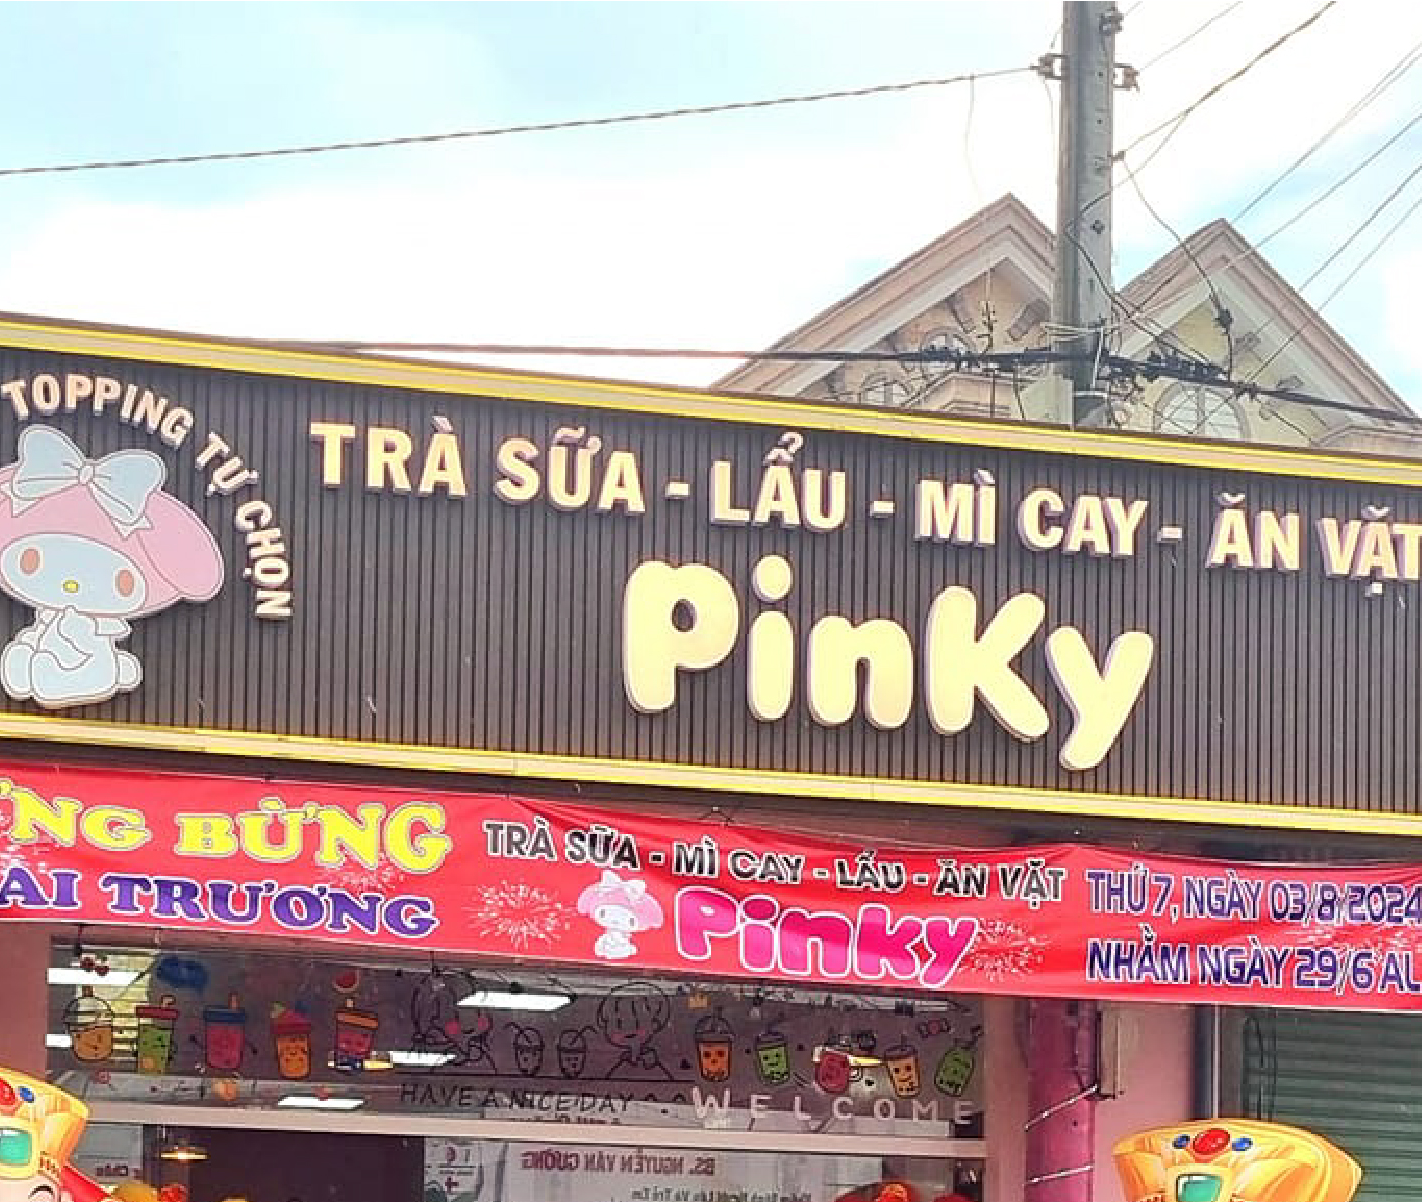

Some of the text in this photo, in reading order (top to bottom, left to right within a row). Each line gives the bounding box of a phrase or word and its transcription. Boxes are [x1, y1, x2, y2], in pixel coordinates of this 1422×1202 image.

[1, 372, 194, 448] TOPPING
[195, 431, 258, 499] TỰ
[233, 498, 293, 621] CHỌN
[309, 416, 467, 498] TRÀ
[493, 427, 646, 513] SỮA
[709, 431, 847, 532] LẨU
[913, 469, 996, 547] MÌ
[1017, 487, 1149, 557] CAY
[1205, 492, 1301, 571] ĂN
[174, 797, 453, 874] BỪNG
[483, 816, 557, 862] TRÀ
[564, 822, 640, 871] SỮA
[673, 834, 720, 879] MÌ
[727, 854, 806, 886] CAY
[998, 857, 1067, 909] VẶT
[101, 872, 440, 939] TRƯƠNG
[1084, 860, 1149, 915] THỨ
[1182, 869, 1264, 923] NGÀY
[1084, 922, 1191, 984] NHẰM
[1197, 935, 1290, 988] NGÀY
[1293, 946, 1380, 996] 29/6
[399, 1083, 476, 1106] HAVE
[508, 1088, 572, 1112] NICE
[578, 1092, 634, 1113] DAY
[691, 1085, 974, 1125] WELCOME
